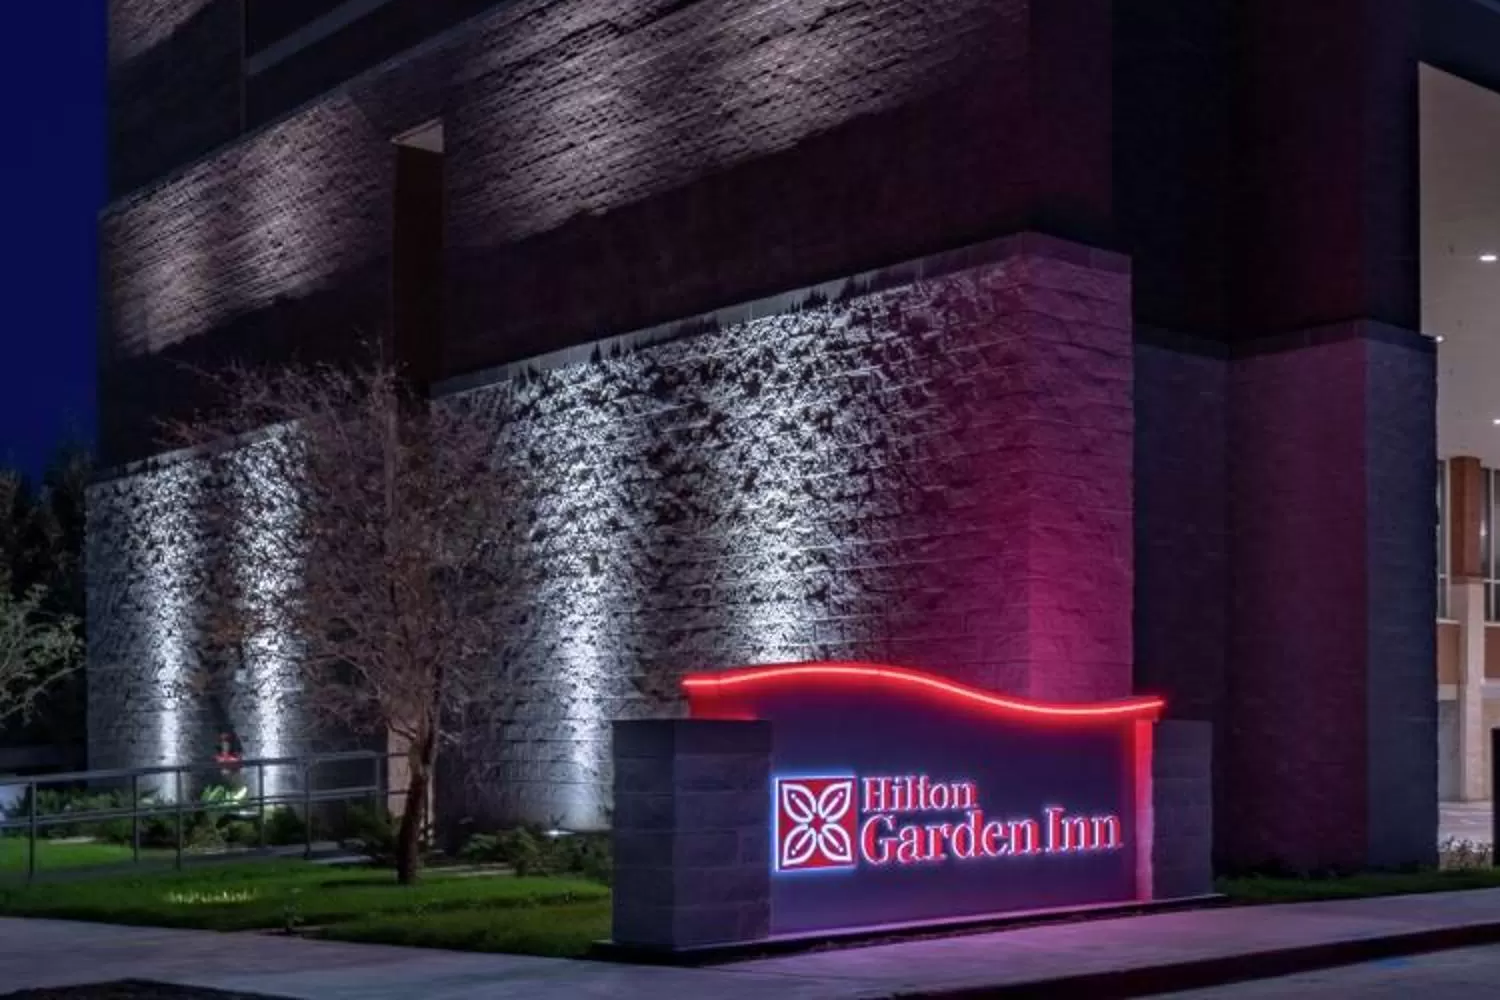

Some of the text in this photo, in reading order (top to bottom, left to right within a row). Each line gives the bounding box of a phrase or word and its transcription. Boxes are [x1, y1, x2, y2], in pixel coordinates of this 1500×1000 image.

[862, 775, 979, 812] Hilton
[861, 806, 1123, 866] Garden Inn
